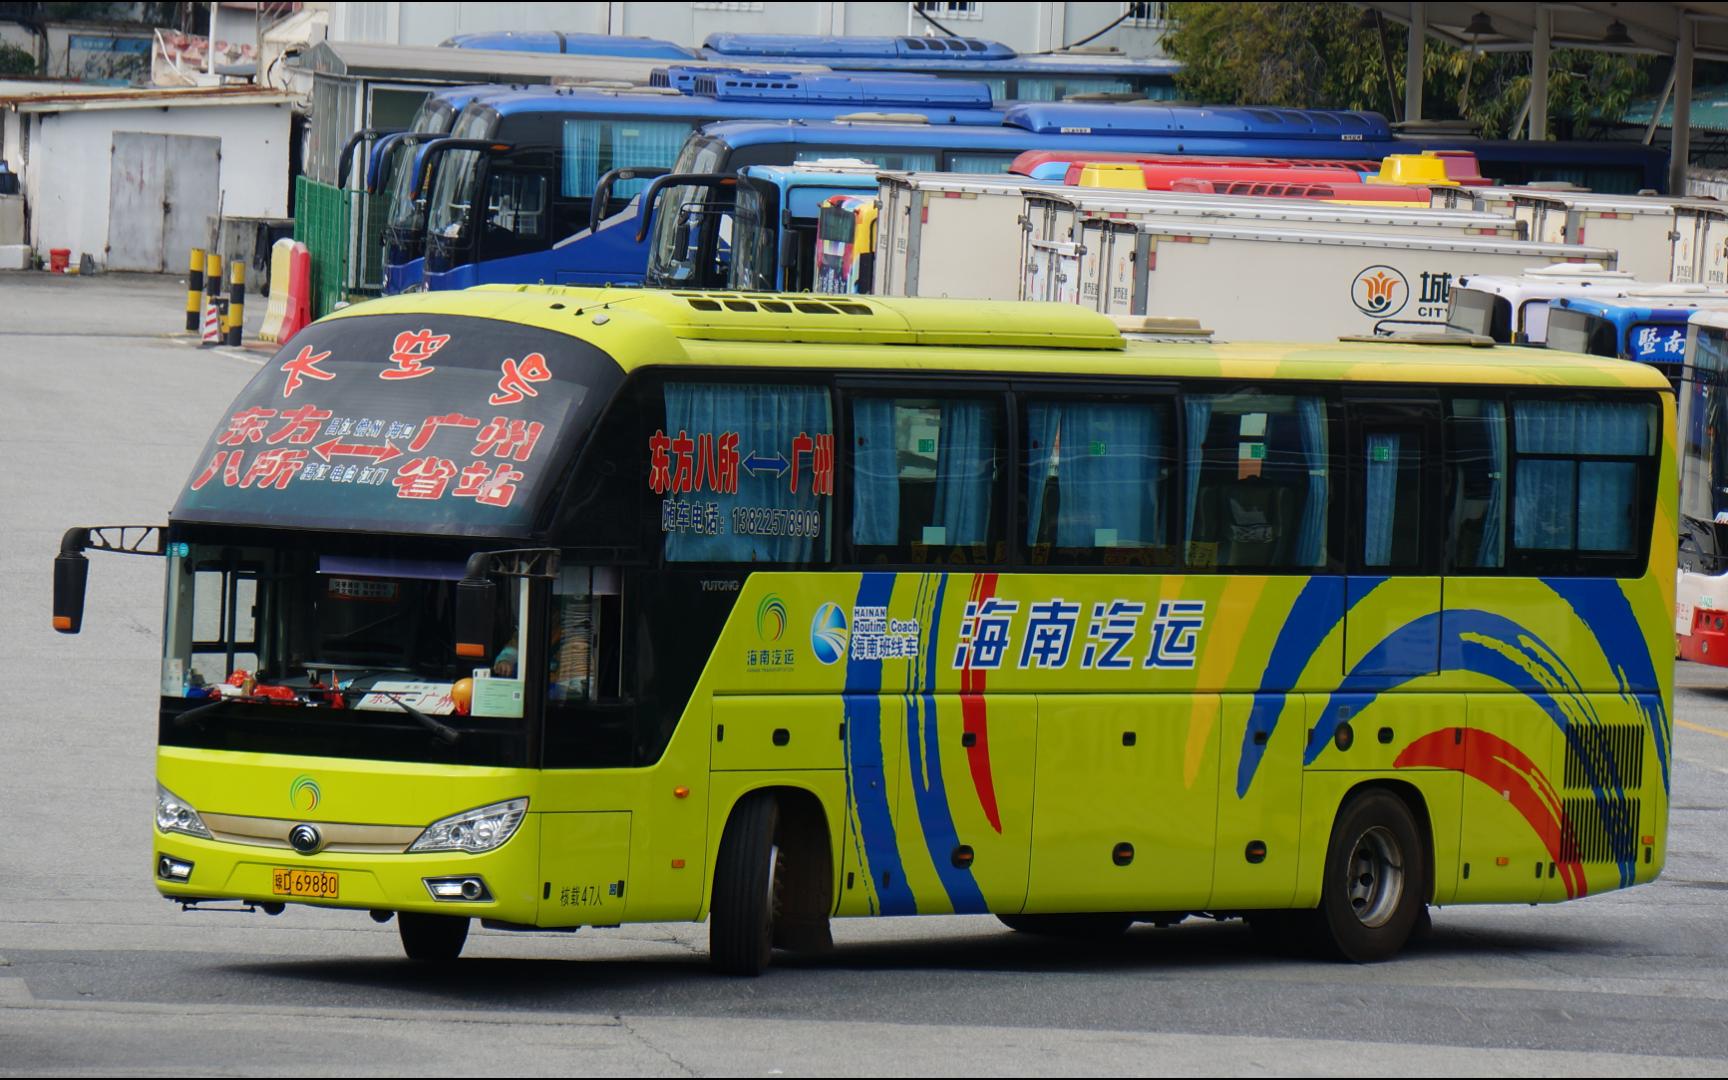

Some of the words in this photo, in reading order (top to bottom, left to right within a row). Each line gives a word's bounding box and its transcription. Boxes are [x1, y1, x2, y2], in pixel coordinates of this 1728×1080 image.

[1418, 306, 1448, 318] CIT
[217, 404, 333, 445] 东方
[408, 412, 545, 461] 广州
[191, 448, 310, 490] 八所
[649, 429, 740, 494] 东方八所
[790, 431, 834, 496] 广州
[393, 456, 524, 507] 省站
[732, 506, 820, 538] 13822578909
[700, 580, 739, 591] YUTONG
[853, 619, 887, 633] Routine
[890, 619, 919, 633] Coach
[854, 607, 887, 618] HAINAN
[851, 635, 919, 660] 海南班线车
[952, 598, 1205, 669] 海南汽运
[747, 648, 795, 665] 海南汽运
